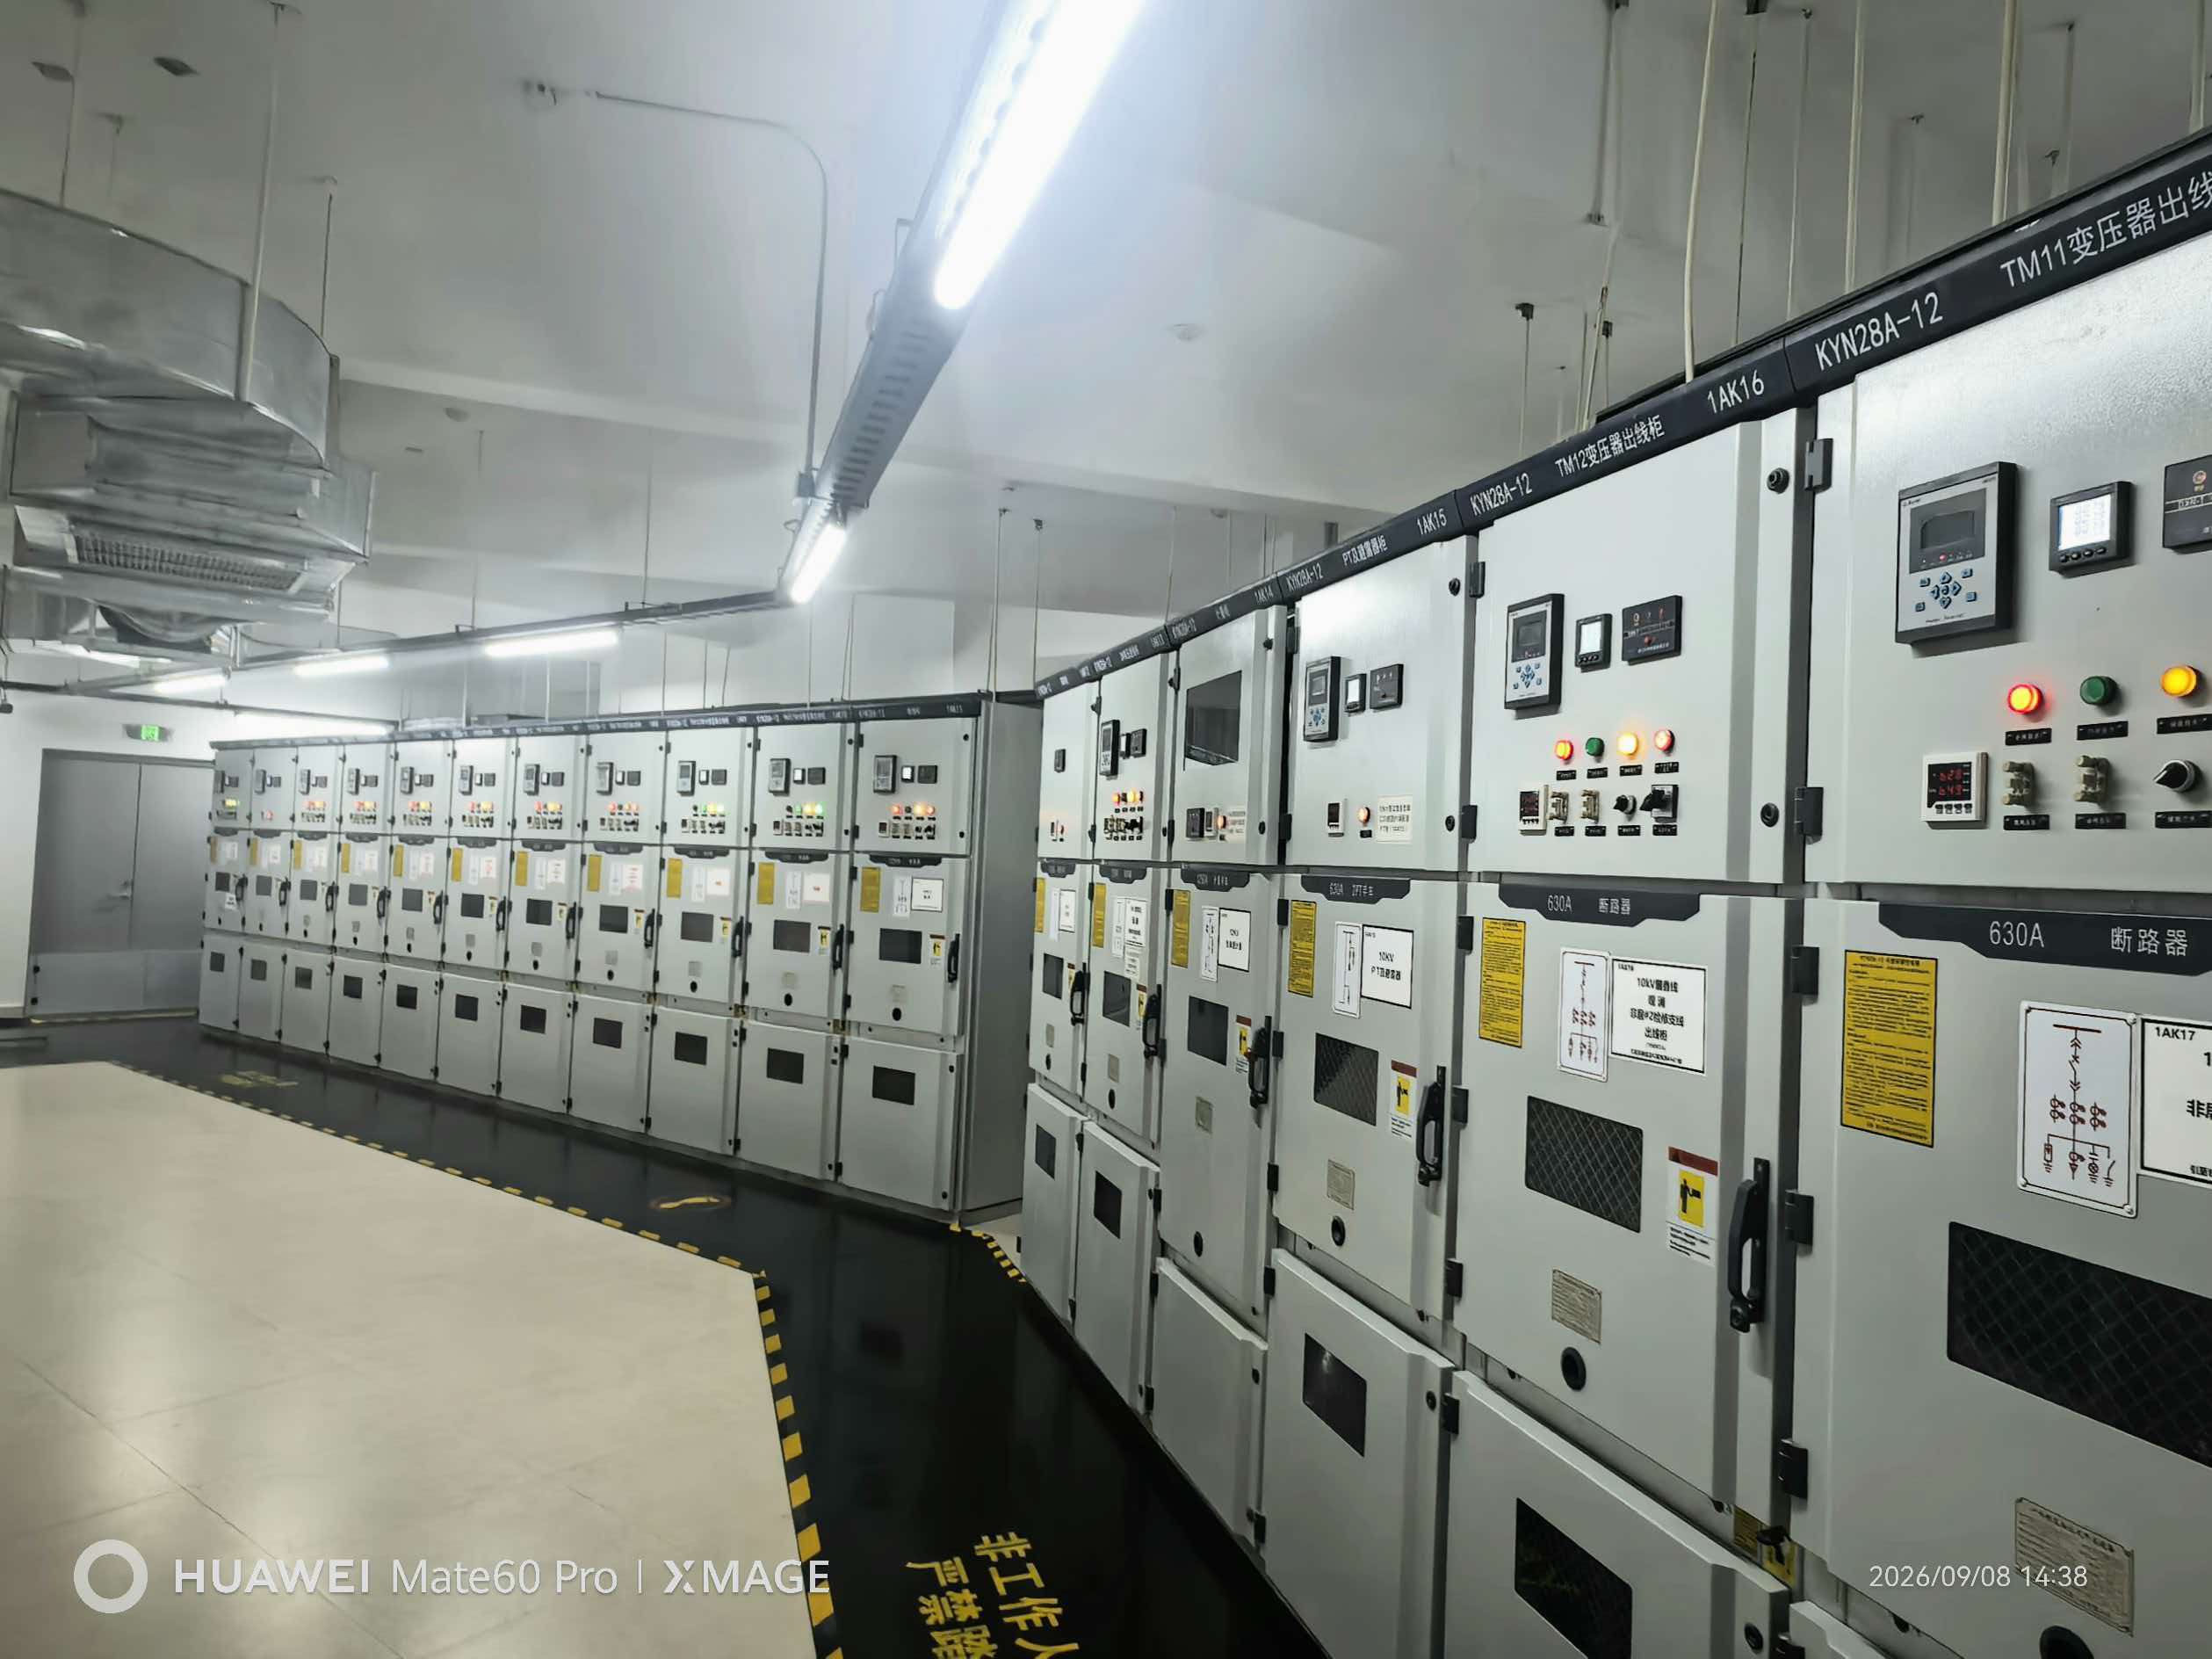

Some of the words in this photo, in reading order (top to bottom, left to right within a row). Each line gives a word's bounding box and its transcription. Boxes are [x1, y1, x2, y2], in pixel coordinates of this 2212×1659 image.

[1815, 293, 1943, 371] KYN28A-12
[2000, 171, 2212, 287] TM11变压器出线
[1470, 473, 1532, 516] KYN28A-12
[1555, 415, 1665, 477] TM12变压器出线柜
[1707, 370, 1765, 415] 1AK16
[1417, 508, 1448, 535] 1AK15
[1548, 895, 1572, 913] 630A
[1599, 897, 1630, 915] 断路器
[1989, 921, 2045, 948] 630A
[2110, 926, 2188, 957] 断路器
[2155, 1026, 2195, 1040] 1AK17
[974, 1532, 1080, 1659] 非工作人
